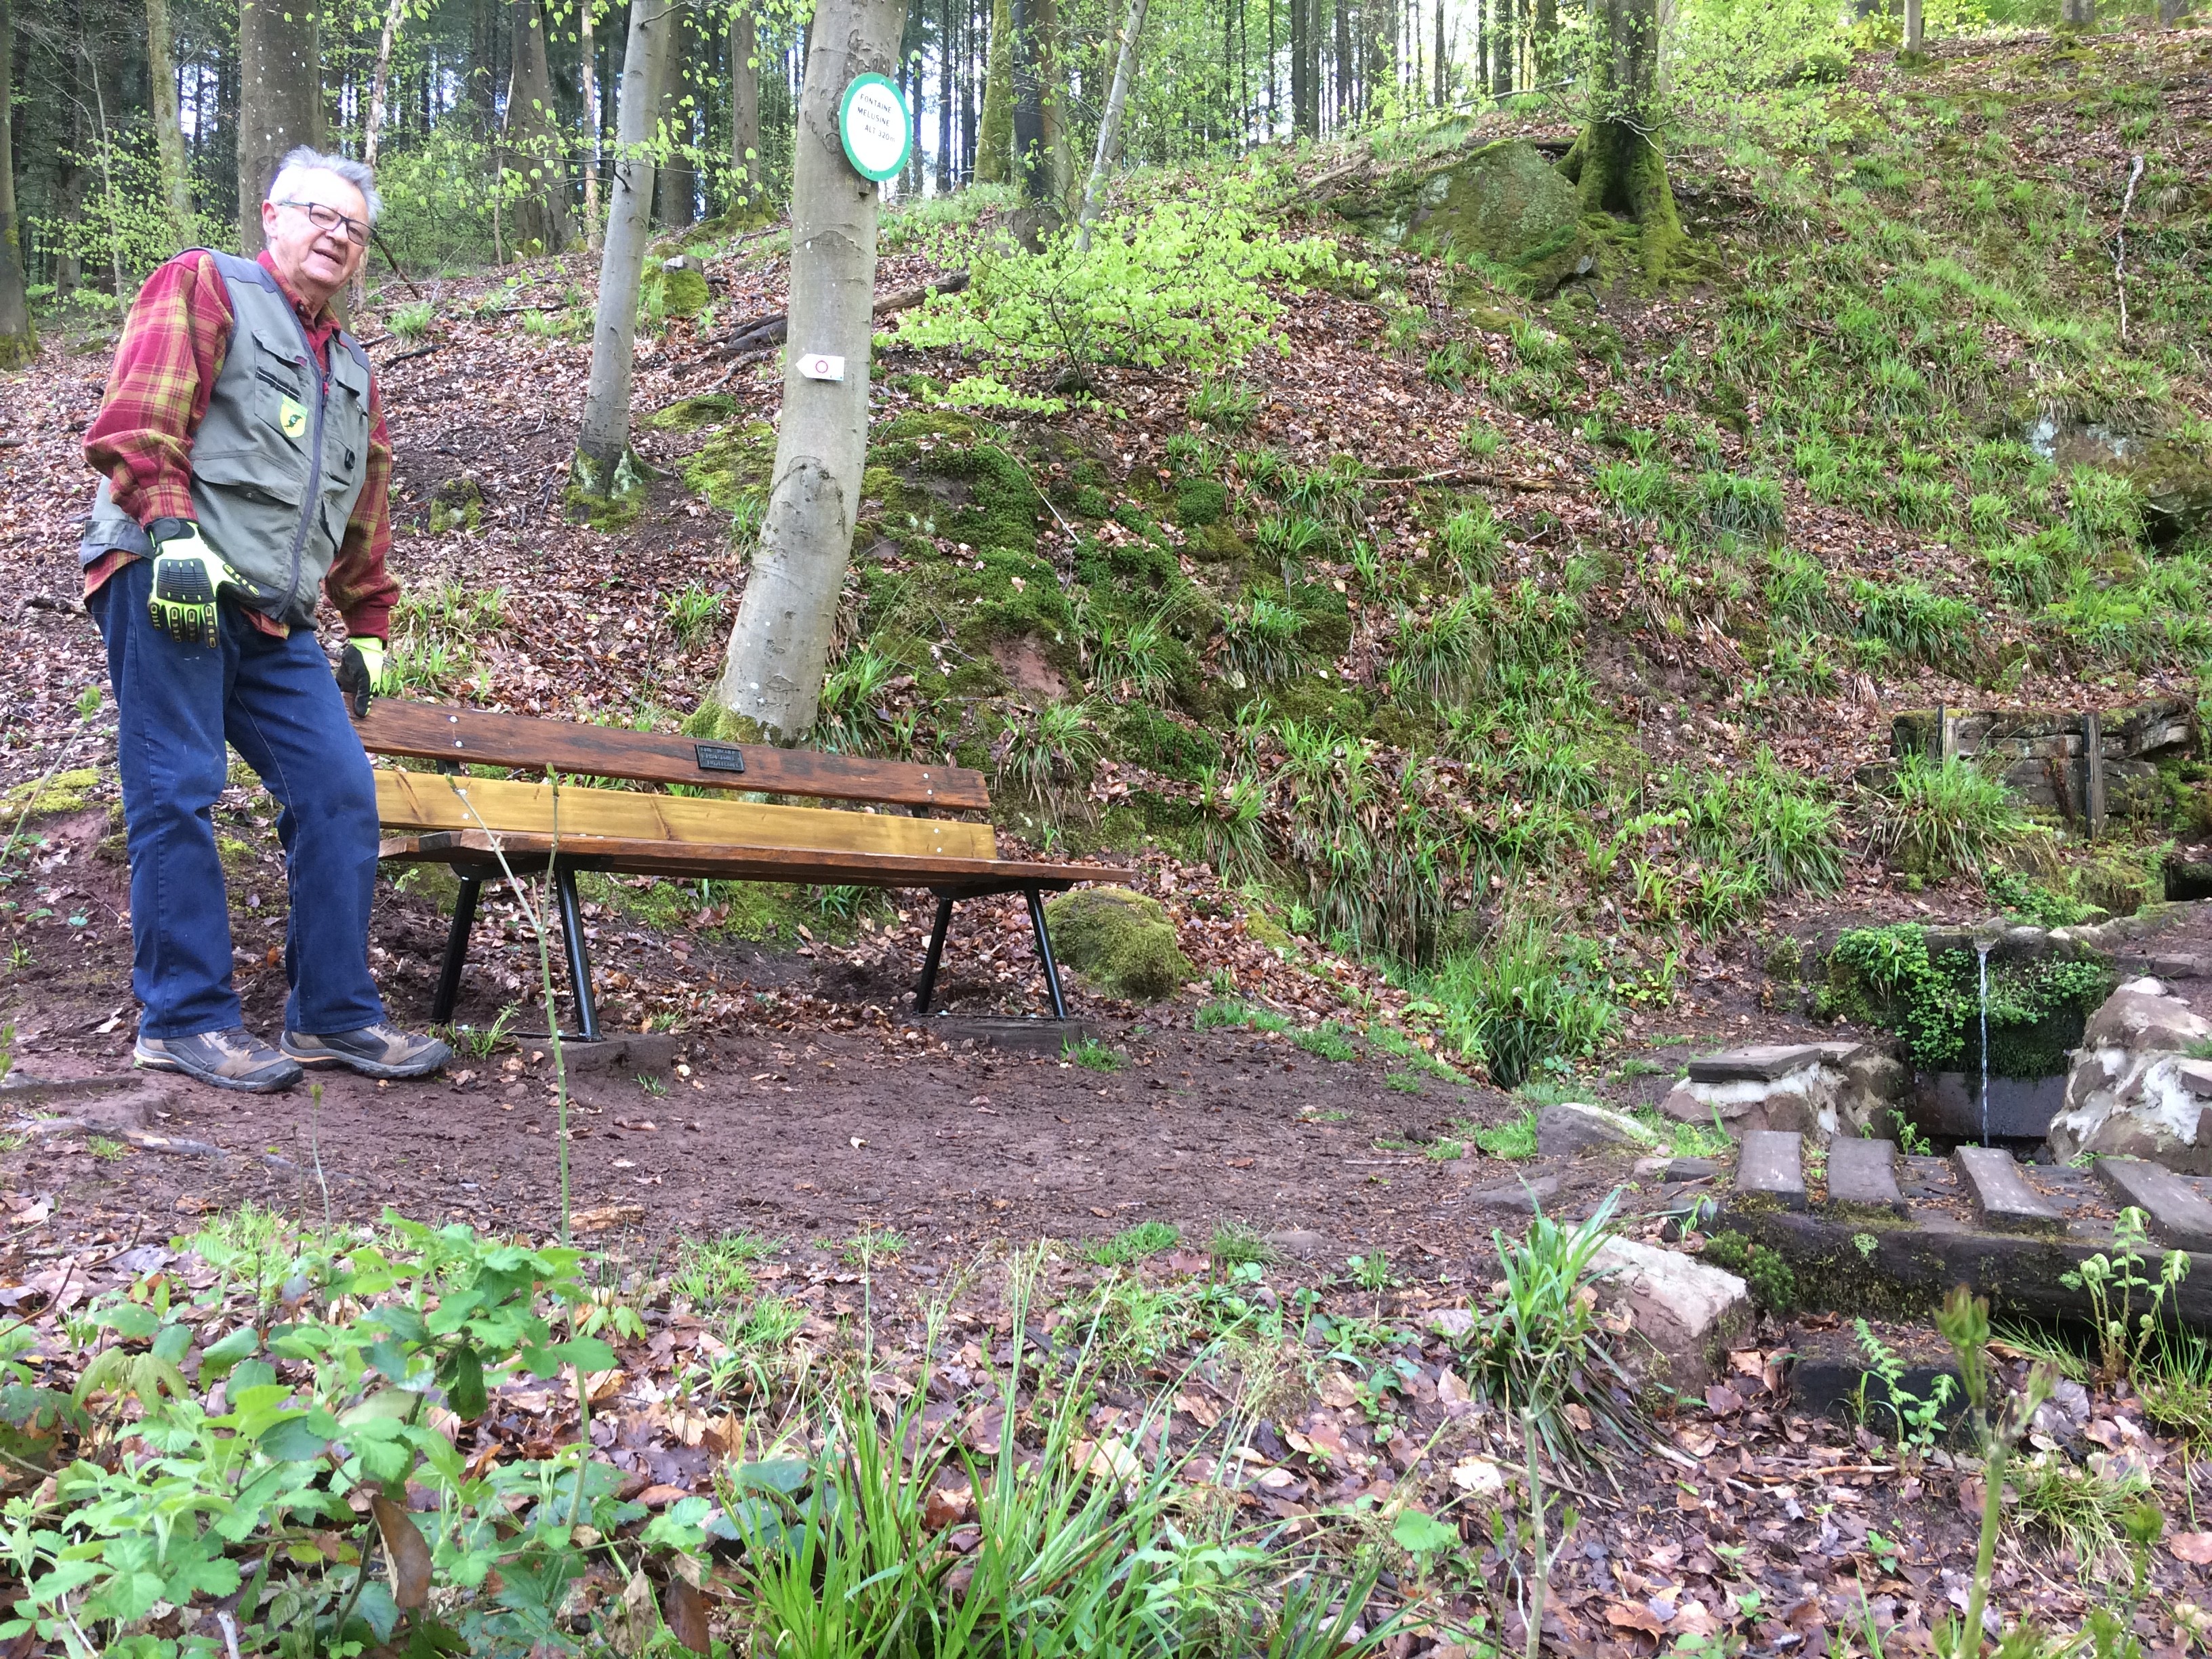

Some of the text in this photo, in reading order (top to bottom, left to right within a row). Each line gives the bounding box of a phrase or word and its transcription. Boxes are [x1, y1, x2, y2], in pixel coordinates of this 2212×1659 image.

[860, 94, 892, 113] FONTAINE
[857, 106, 890, 127] MELUSINE
[864, 124, 876, 134] ALT
